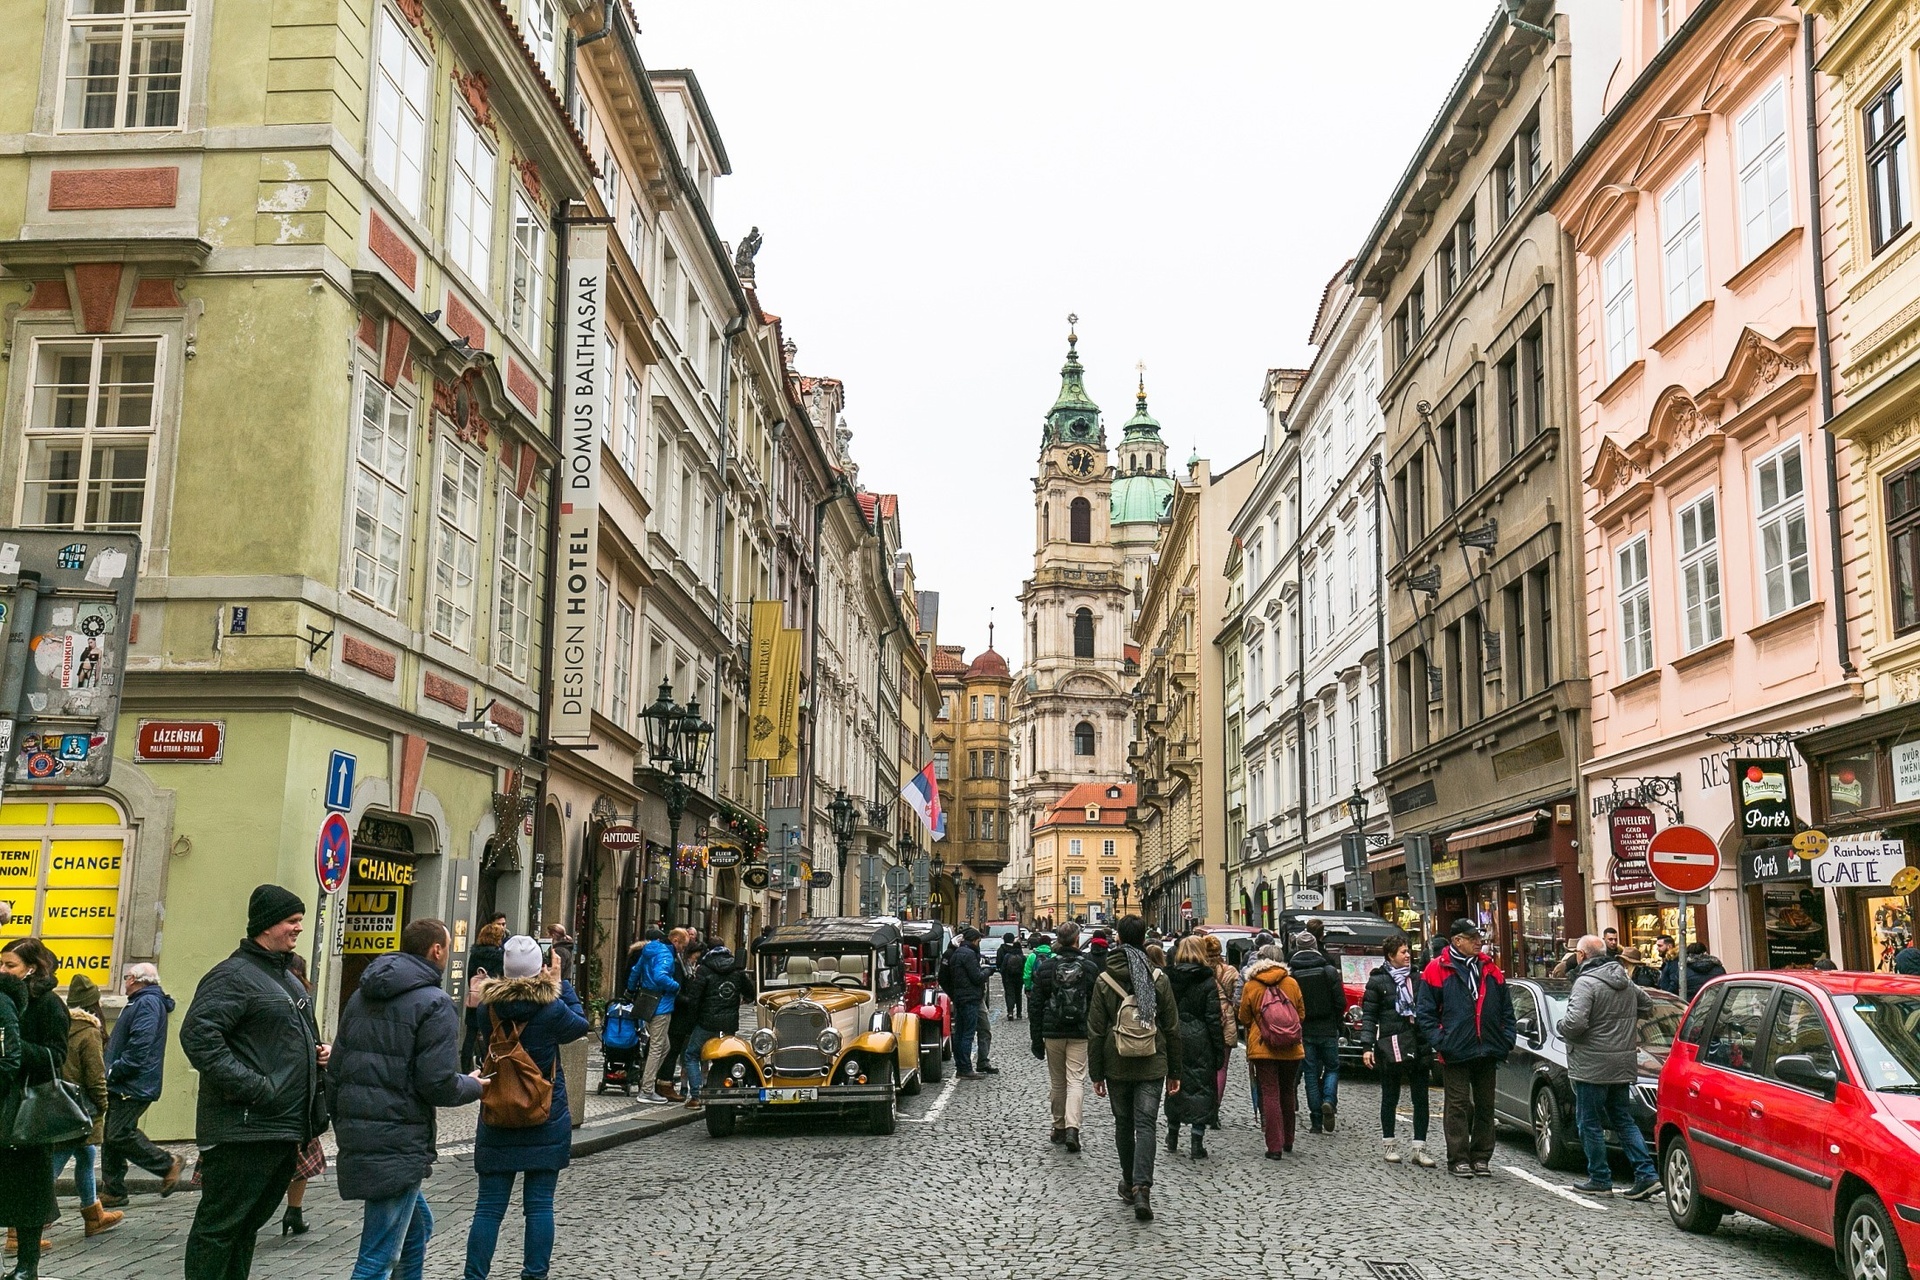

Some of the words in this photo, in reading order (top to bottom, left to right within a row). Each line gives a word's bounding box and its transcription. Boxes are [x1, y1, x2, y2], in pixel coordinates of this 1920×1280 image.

[575, 275, 598, 395] BALTHASAR
[572, 404, 593, 489] DOMUS
[567, 527, 589, 616] HOTEL
[63, 635, 73, 688] HEROINKIDS
[562, 625, 585, 716] DESIGN
[758, 638, 771, 708] RESTAURACE
[153, 728, 203, 743] LÁZEŇSKÁ
[149, 744, 162, 753] MALÁ
[163, 745, 181, 753] STRANA
[183, 745, 200, 753] PRAHA
[1614, 815, 1651, 827] JEWELLERY
[1745, 808, 1790, 828] Pork's
[602, 832, 640, 843] ANTIQUE
[1806, 835, 1817, 845] 10
[1833, 844, 1881, 857] Rainbow's
[1883, 844, 1903, 856] End
[53, 856, 121, 870] CHANGE
[358, 857, 413, 886] CHANGE
[1753, 854, 1779, 879] Pork's
[1817, 858, 1882, 884] CAFÉ
[48, 906, 115, 918] WECHSEL
[344, 937, 395, 949] HANGE
[57, 956, 110, 969] HANGE
